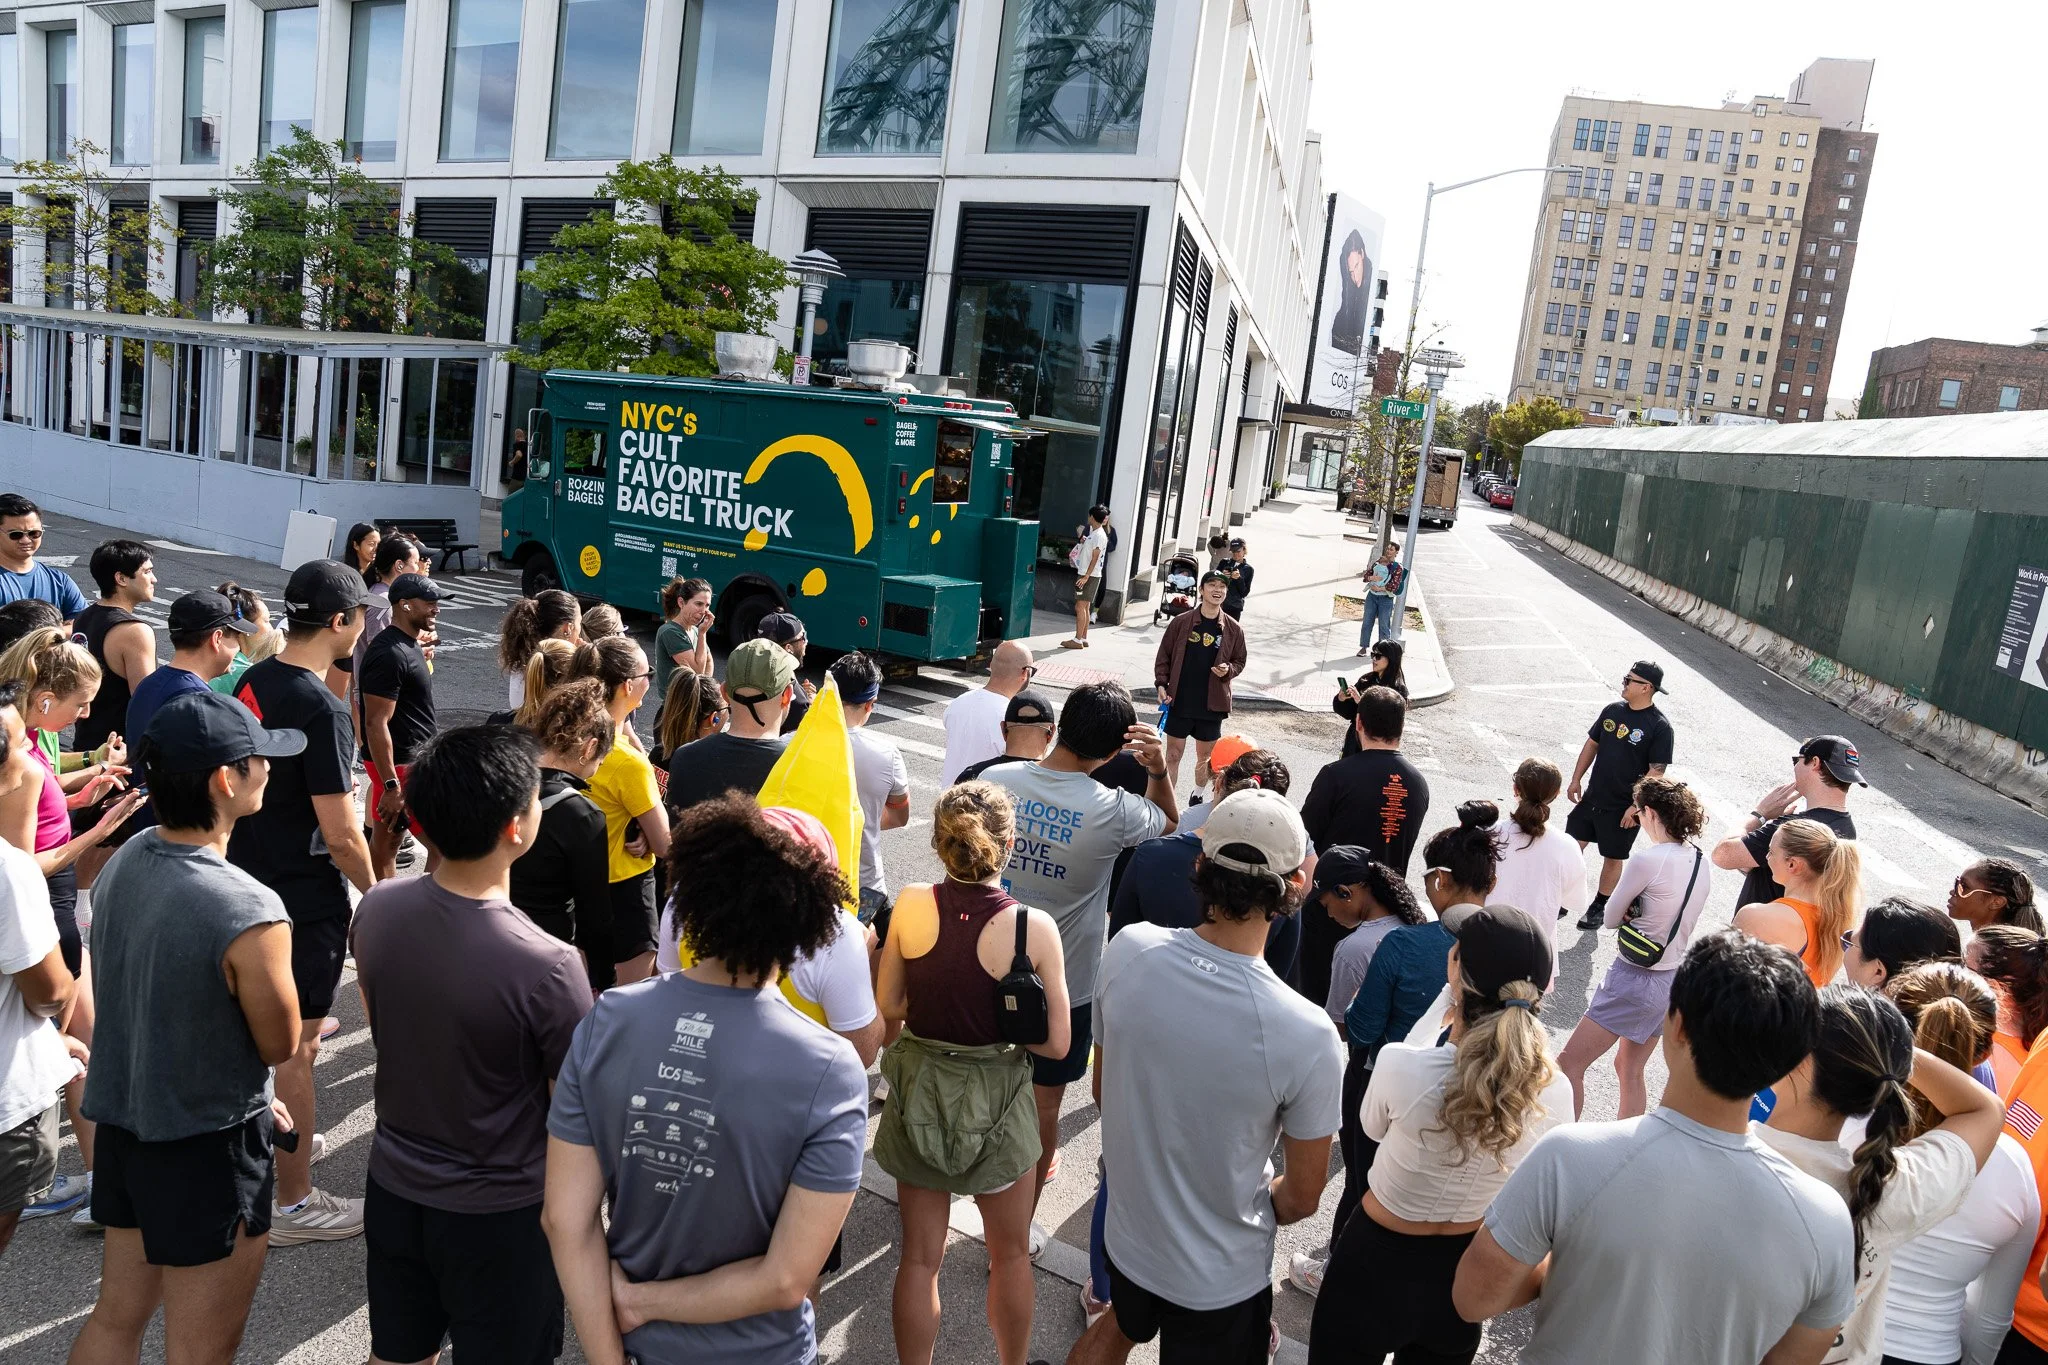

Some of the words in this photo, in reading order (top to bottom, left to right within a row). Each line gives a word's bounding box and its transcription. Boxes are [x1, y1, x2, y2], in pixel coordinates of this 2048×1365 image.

[1331, 372, 1349, 390] COS
[621, 400, 697, 436] NYC's
[1330, 410, 1349, 418] ONE
[1387, 402, 1410, 416] River
[1413, 403, 1420, 412] St
[895, 430, 915, 438] COFFEE
[900, 439, 916, 447] MORE
[620, 429, 683, 462] CULT
[618, 457, 742, 500] FAVORITE
[568, 490, 604, 506] BAGELS
[616, 485, 695, 523] BAGEL
[701, 498, 794, 538] TRUCK
[663, 541, 675, 549] WANT
[2018, 568, 2033, 580] Work
[2033, 570, 2038, 581] in
[2039, 572, 2048, 586] Pro
[1016, 798, 1084, 829] HOOSE
[1015, 816, 1073, 844] ETTER
[1014, 837, 1051, 860] OVE
[1008, 854, 1067, 880] ETTER
[676, 1034, 706, 1050] MILE
[658, 1062, 682, 1081] tcs
